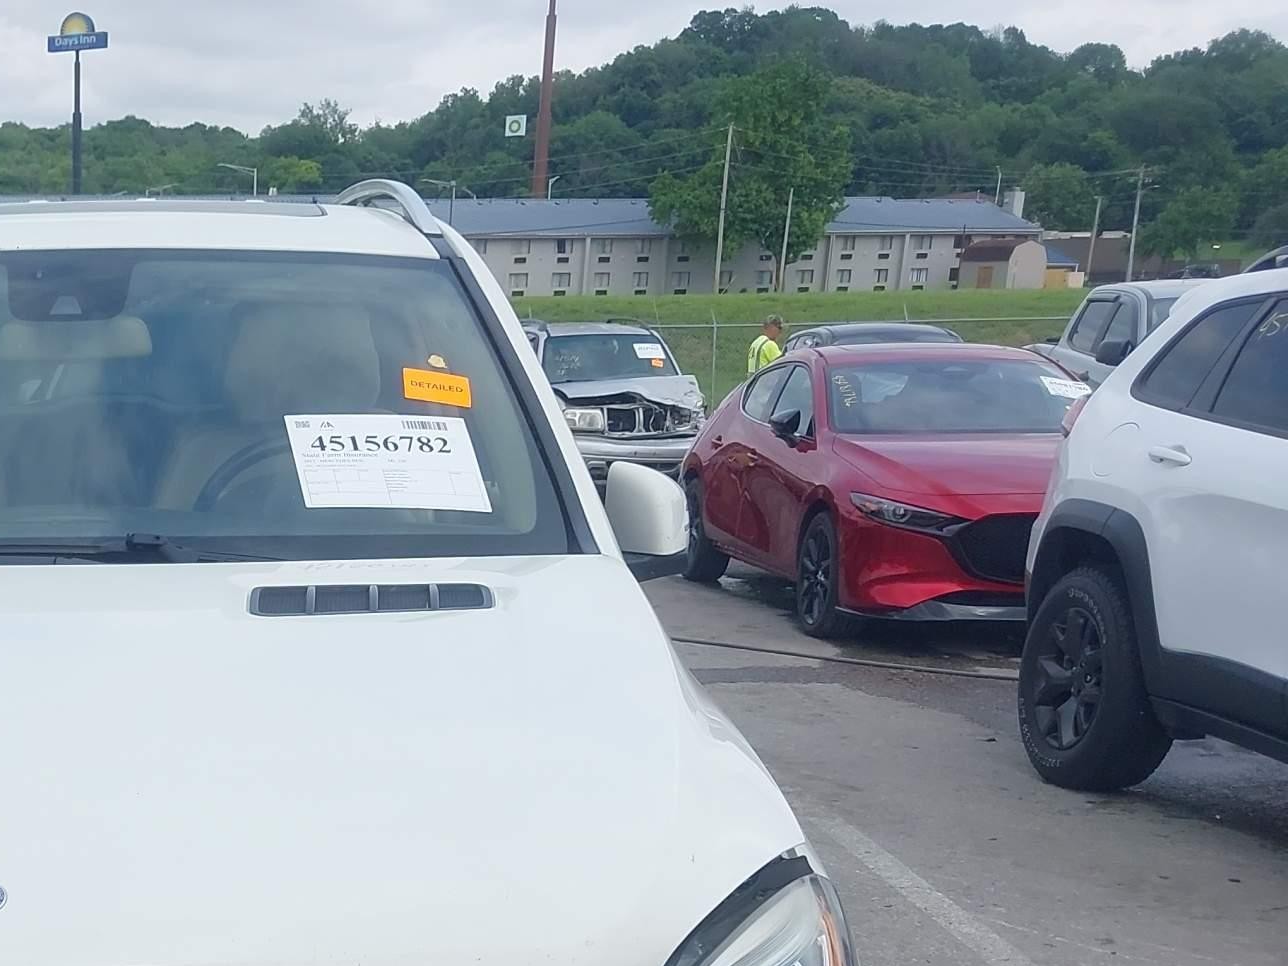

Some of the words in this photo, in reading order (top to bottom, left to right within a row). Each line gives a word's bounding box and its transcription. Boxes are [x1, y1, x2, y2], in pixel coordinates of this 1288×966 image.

[54, 37, 78, 48] Days
[79, 34, 96, 45] Inn
[410, 380, 464, 393] DETAILED
[310, 434, 452, 454] 45156782
